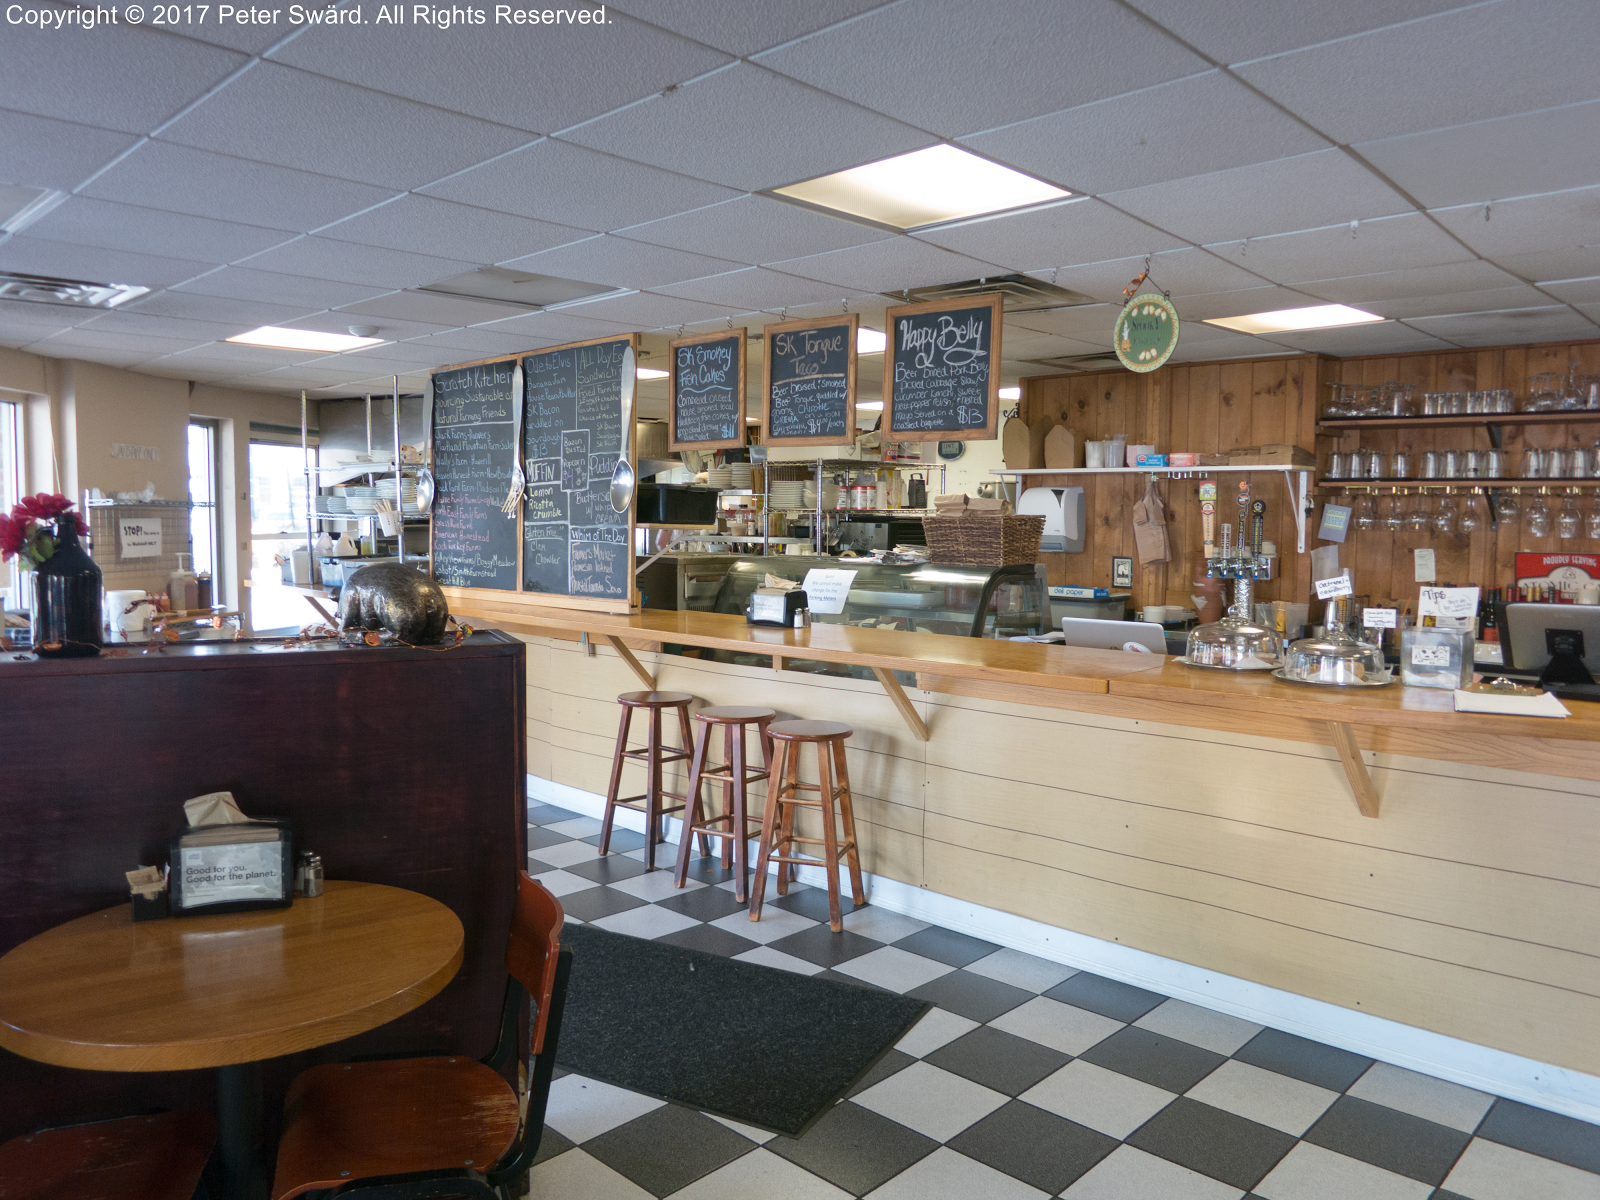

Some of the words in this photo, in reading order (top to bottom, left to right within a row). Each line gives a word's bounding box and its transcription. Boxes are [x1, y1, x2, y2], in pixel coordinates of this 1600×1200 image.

[776, 333, 797, 355] SK
[800, 330, 843, 364] Tongue
[900, 319, 937, 368] Happy
[937, 314, 987, 366] Belly
[527, 357, 545, 373] Ode
[546, 357, 552, 370] to
[552, 352, 571, 369] Elvis
[596, 346, 612, 368] Day
[678, 347, 695, 367] SK
[696, 346, 732, 371] Smokey
[789, 355, 819, 375] Taco
[435, 371, 473, 393] Scratch
[475, 365, 514, 388] Kitchen
[578, 368, 617, 383] Sandwich
[680, 369, 698, 387] Fish
[699, 365, 725, 384] Cakes
[895, 362, 918, 382] Beer
[950, 364, 968, 376] Pork
[527, 378, 552, 390] Banana
[553, 373, 567, 385] Jam
[597, 384, 612, 394] Farm
[435, 396, 464, 408] Sourcing
[465, 388, 504, 403] Sustainable
[527, 390, 545, 402] House
[772, 386, 789, 399] Beer
[435, 408, 459, 424] Natural
[482, 405, 506, 418] Friends
[527, 403, 538, 416] SK
[540, 402, 560, 415] Bacon
[957, 405, 984, 424] $13
[555, 419, 564, 427] on
[722, 423, 735, 439] $11
[531, 443, 548, 458] $13
[526, 460, 555, 482] MUFFIN
[564, 458, 586, 468] Popcorn
[589, 456, 618, 476] Puddin
[530, 487, 553, 497] Lemon
[529, 499, 554, 509] Ricotta
[533, 507, 562, 519] crumble
[124, 526, 142, 536] STOP!
[525, 526, 545, 538] Gluten
[572, 529, 591, 540] Whim
[593, 528, 600, 541] of
[600, 527, 612, 542] The
[613, 528, 625, 543] Day
[530, 540, 546, 551] Clam
[1543, 556, 1570, 565] PROUDLY
[1572, 556, 1597, 567] SERVING
[1422, 588, 1446, 604] Tips
[186, 867, 211, 875] Good
[228, 865, 247, 873] you.
[186, 875, 211, 883] Good
[246, 870, 276, 880] planet.
